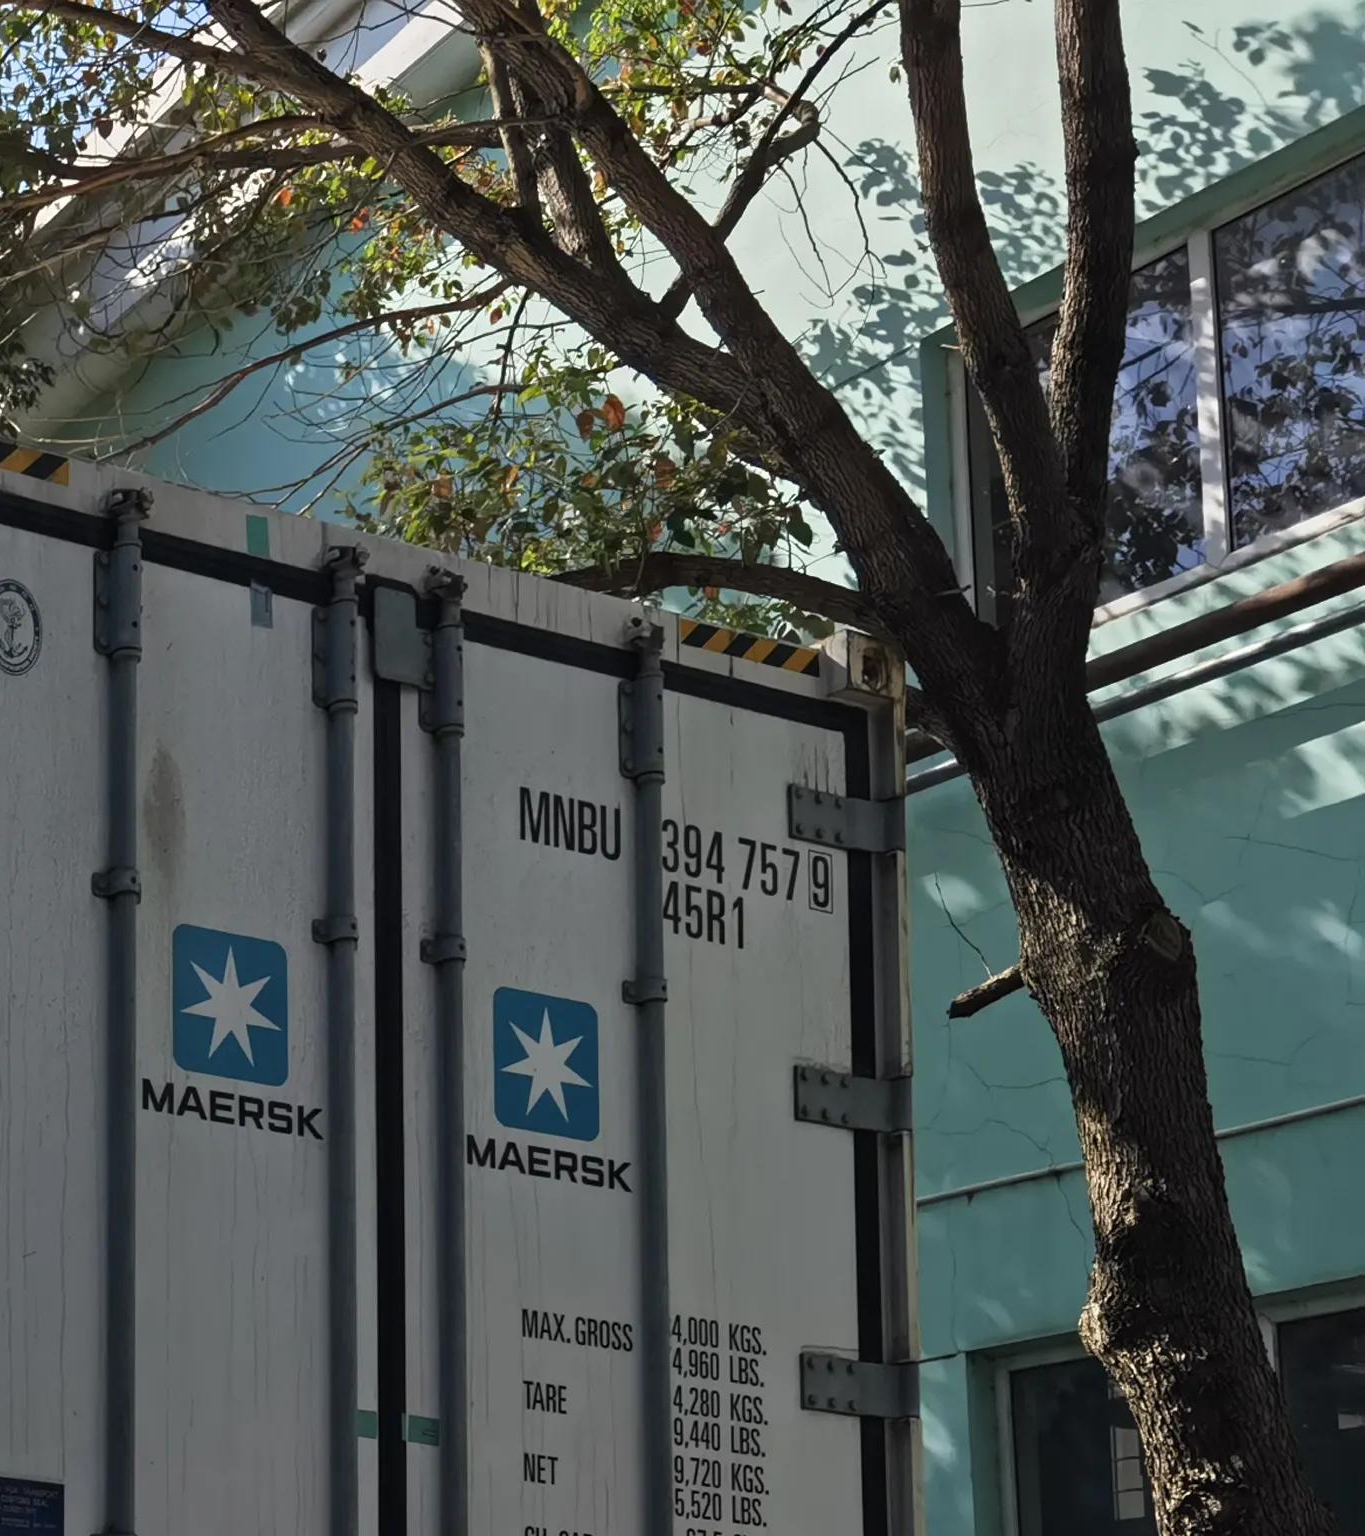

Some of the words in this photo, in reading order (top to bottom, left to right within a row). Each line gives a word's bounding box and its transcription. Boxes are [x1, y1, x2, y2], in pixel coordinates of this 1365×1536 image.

[519, 786, 622, 861] MNBU
[661, 819, 725, 885] 394
[738, 837, 800, 901] 757
[811, 854, 830, 909] 9
[662, 880, 744, 950] 45R1
[142, 1078, 324, 1141] MAERSK
[466, 1134, 633, 1194] MAERSK
[521, 1308, 571, 1345] MAX.
[574, 1316, 634, 1352] GROSS
[729, 1323, 767, 1356] KGS.
[729, 1355, 765, 1388] LBS.
[523, 1380, 568, 1415] TARE
[730, 1393, 768, 1426] KGS.
[731, 1425, 766, 1458] LBS.
[523, 1452, 559, 1486] NET
[731, 1462, 770, 1496] KGS.
[732, 1495, 767, 1528] LBS.
